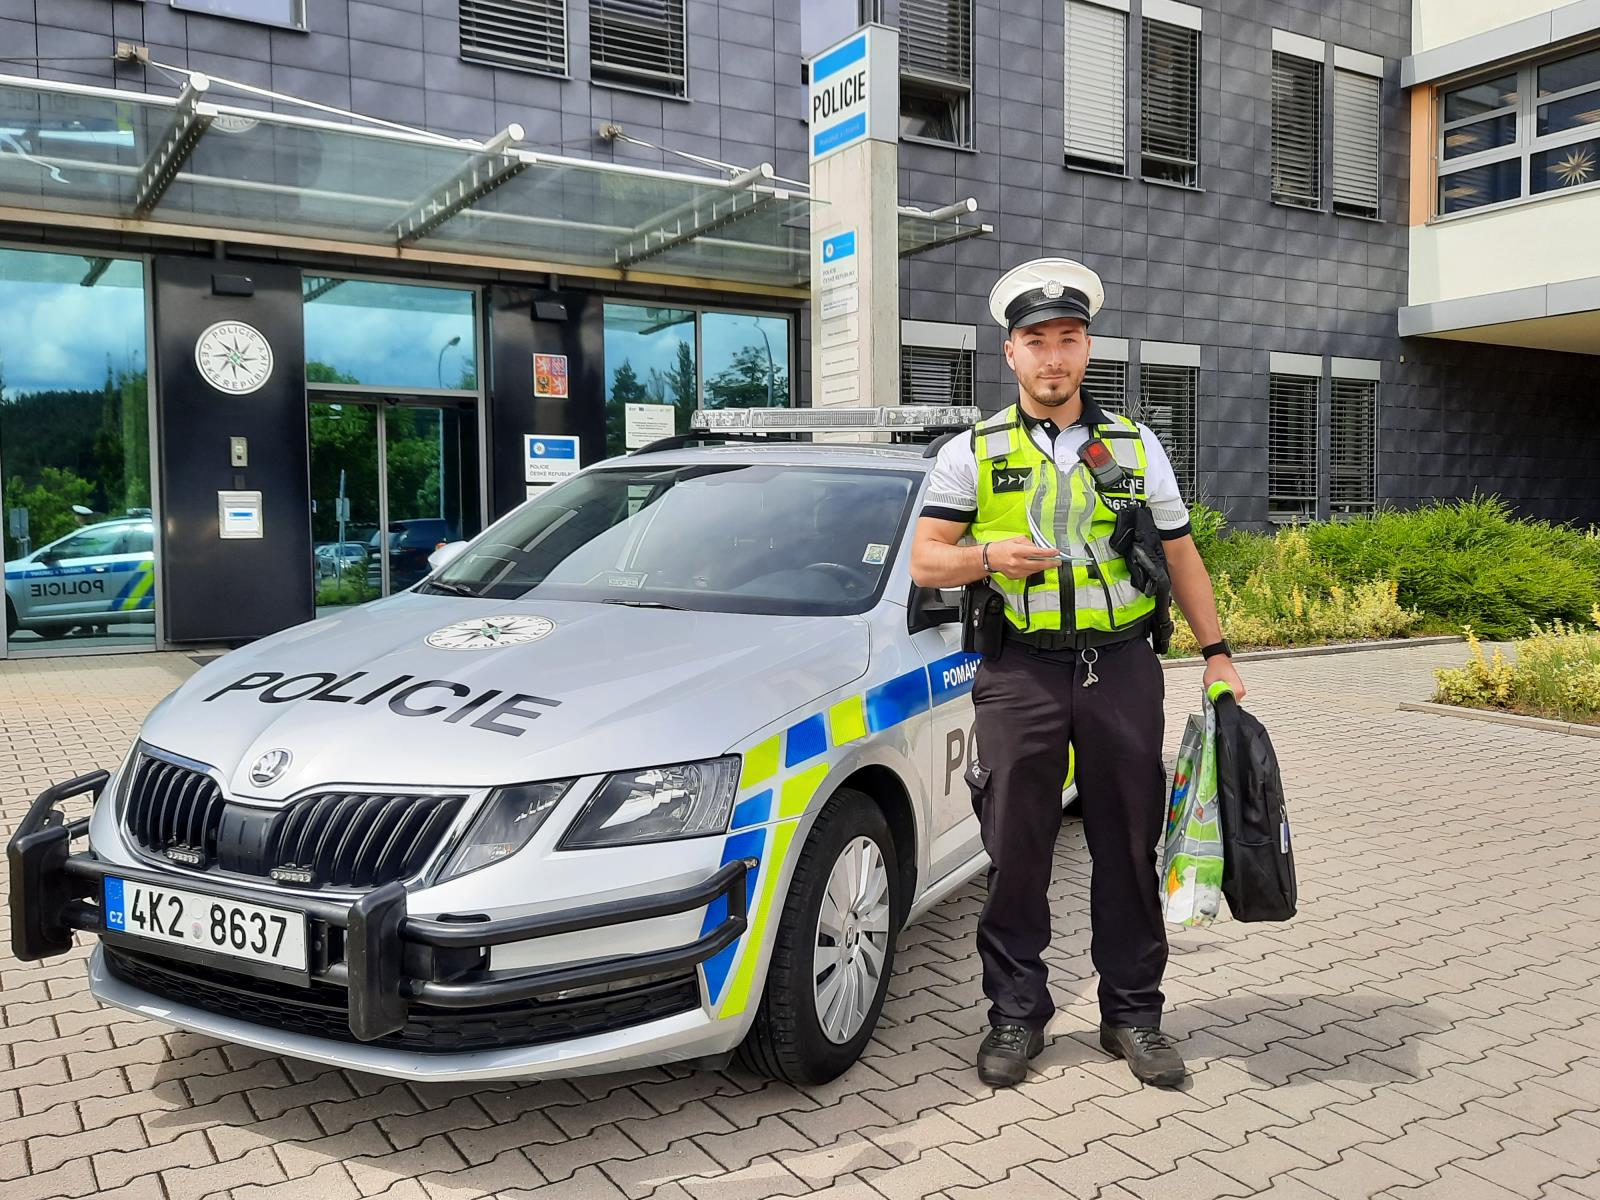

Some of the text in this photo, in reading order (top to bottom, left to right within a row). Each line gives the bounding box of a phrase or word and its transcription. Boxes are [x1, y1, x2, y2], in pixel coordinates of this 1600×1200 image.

[812, 69, 866, 124] POLICIE
[211, 326, 257, 342] POLICIE
[222, 346, 268, 389] REPUBLIKY
[942, 657, 982, 690] POMÁH
[202, 671, 563, 738] POLICIE
[109, 910, 124, 925] CZ
[131, 888, 288, 958] 4K2 8637
